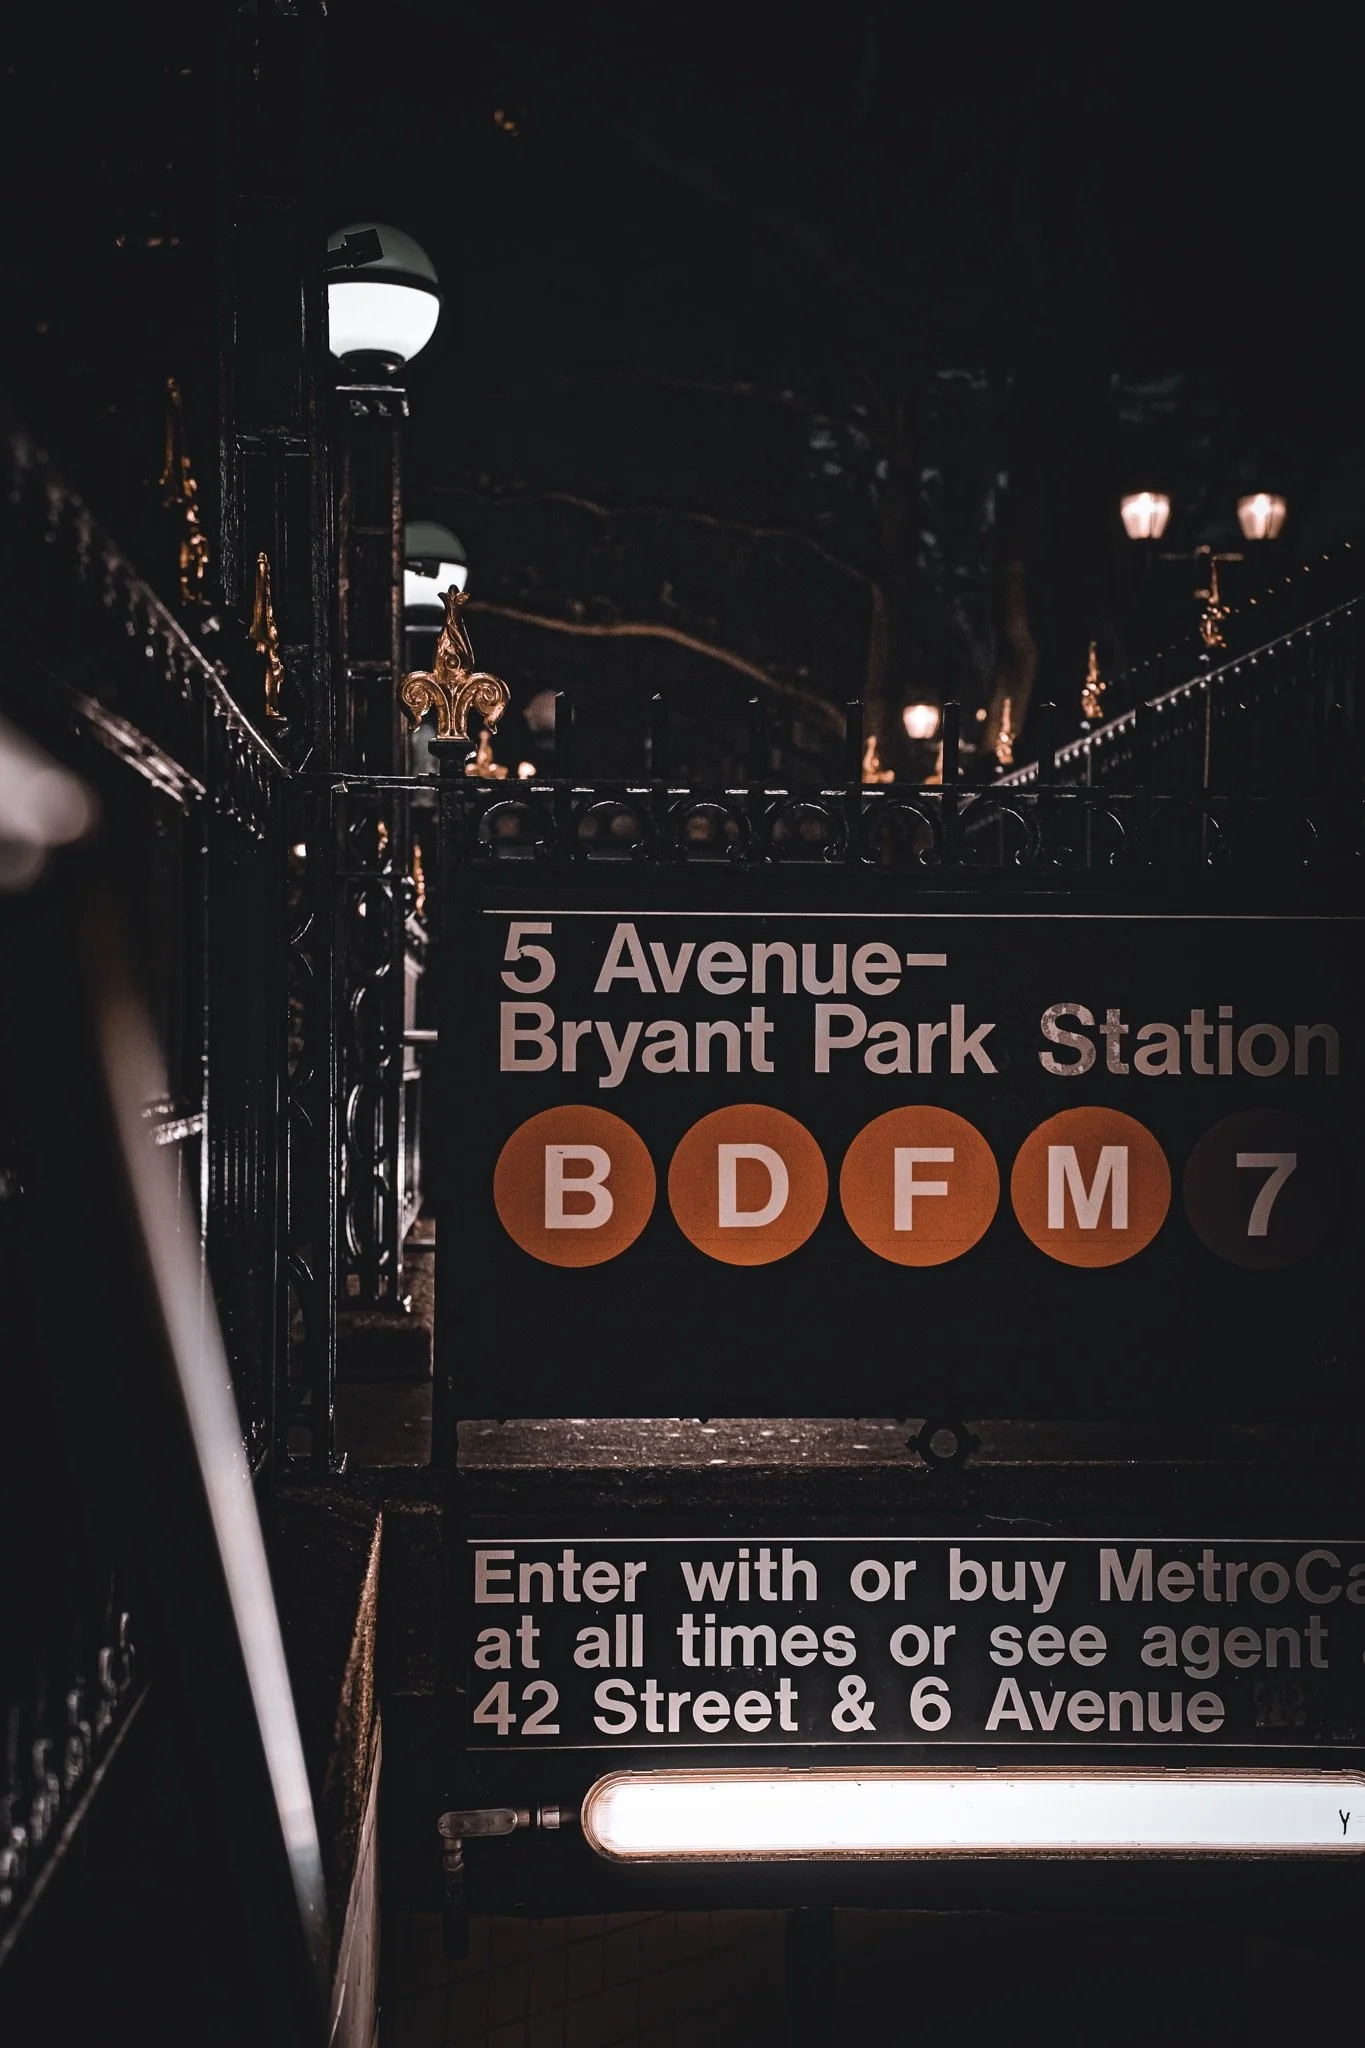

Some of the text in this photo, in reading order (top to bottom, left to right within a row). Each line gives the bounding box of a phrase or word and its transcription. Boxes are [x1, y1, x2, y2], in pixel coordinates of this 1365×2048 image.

[501, 922, 555, 993] 5
[500, 1002, 1340, 1088] Bryant Park Station
[545, 1144, 1297, 1236] B D F M 7
[475, 1549, 646, 1603] Enter
[680, 1548, 817, 1601] with
[850, 1560, 916, 1602] or
[950, 1548, 1066, 1613] buy
[474, 1614, 1328, 1679] at all times or see agent
[474, 1675, 1224, 1735] 42 Street & 6 Avenue
